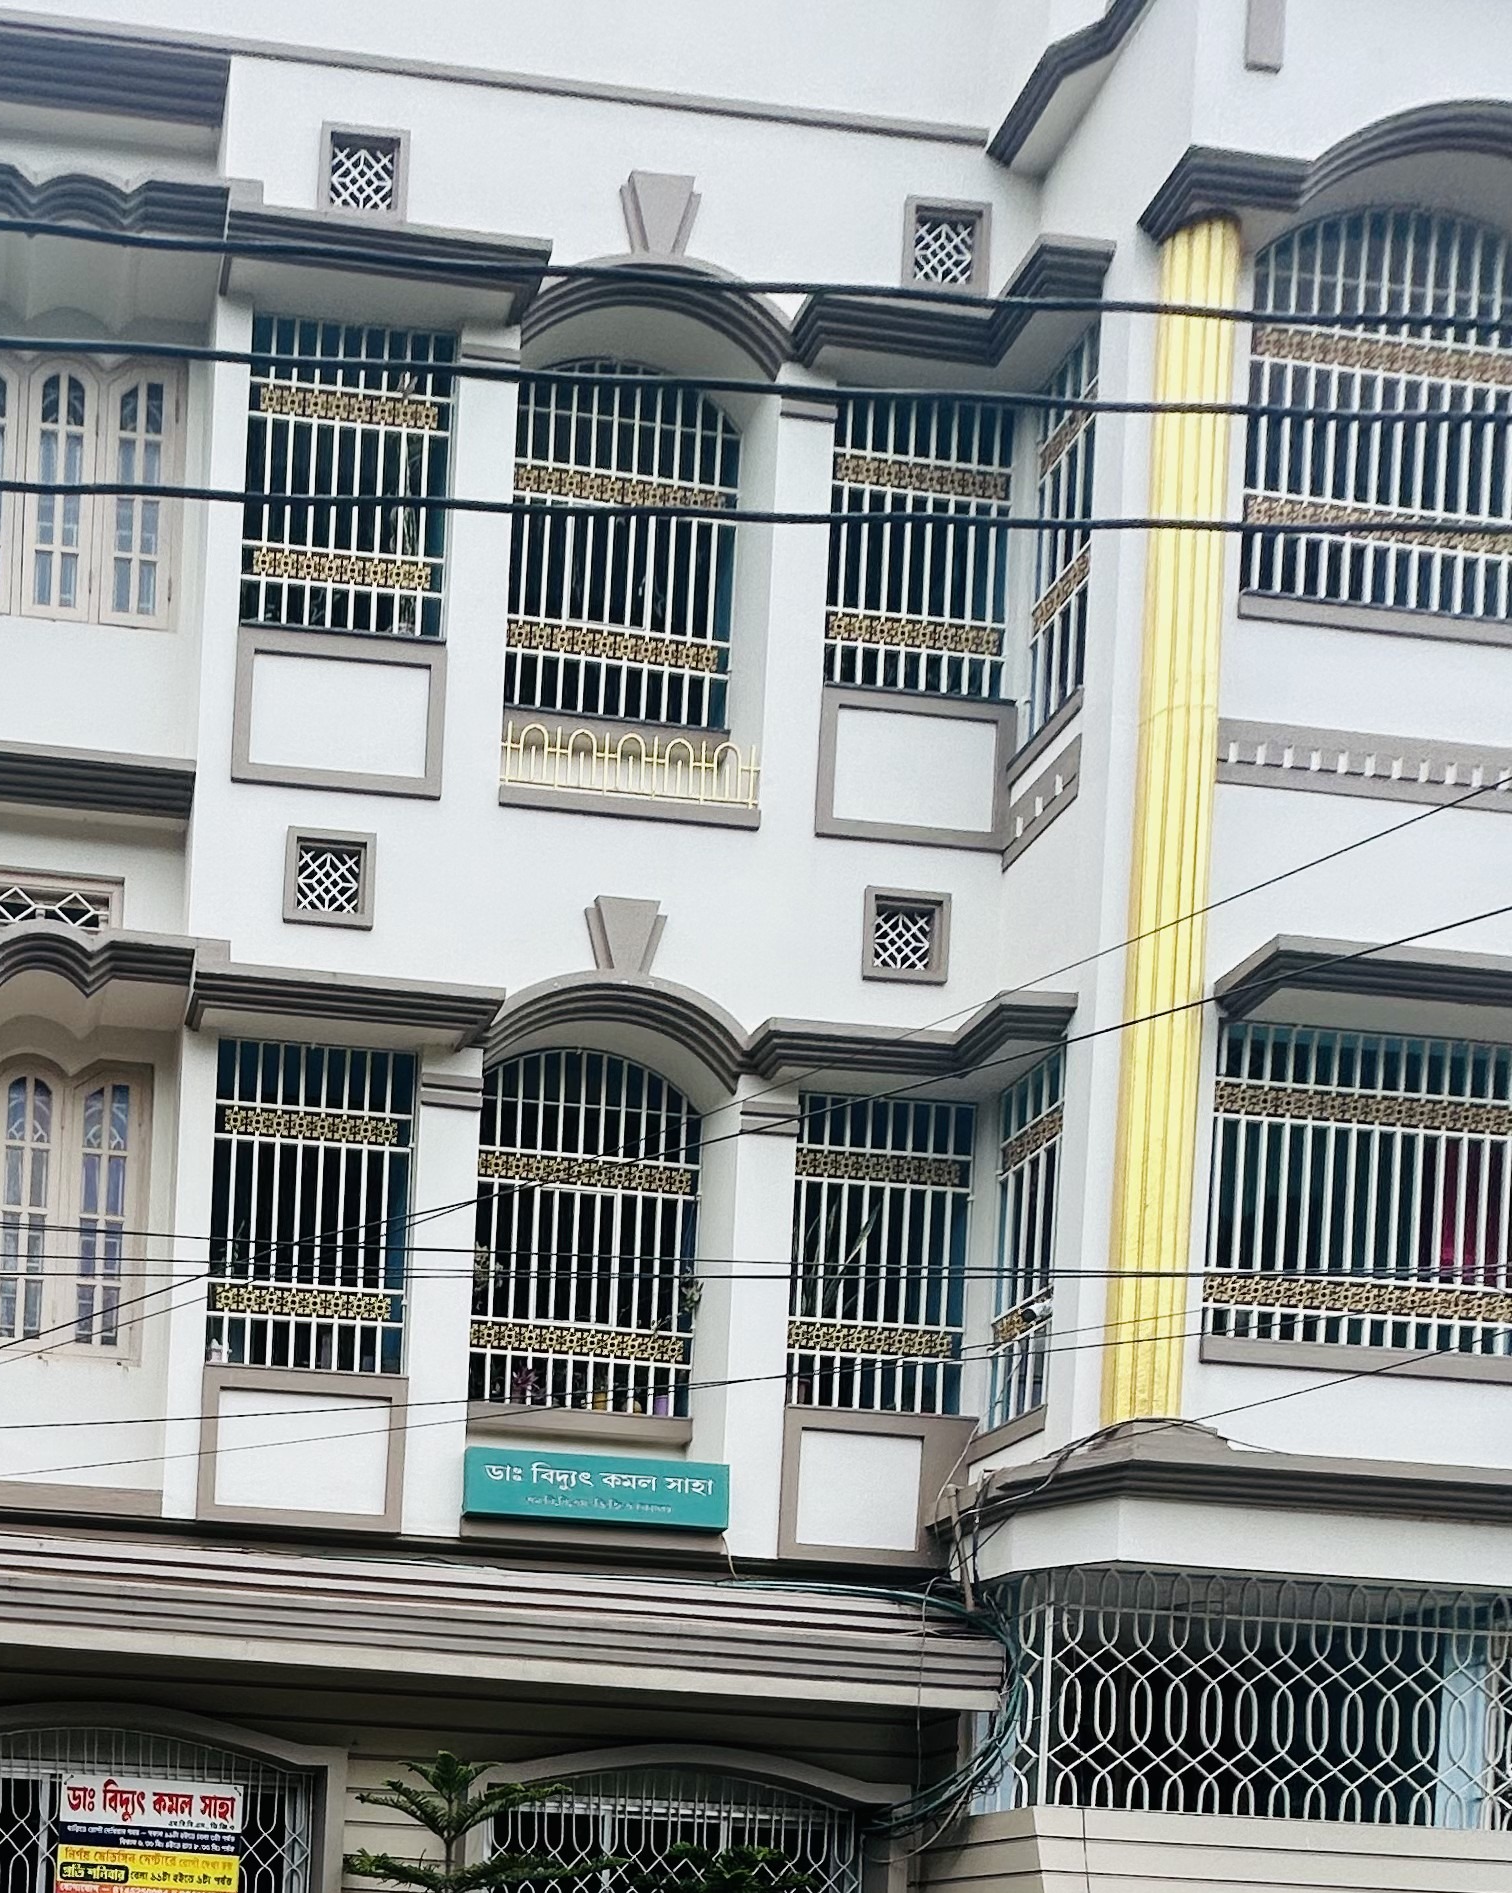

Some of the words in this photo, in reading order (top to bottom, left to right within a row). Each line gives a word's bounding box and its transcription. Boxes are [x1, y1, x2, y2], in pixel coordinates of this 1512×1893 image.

[484, 1464, 523, 1482] ডাঃ
[531, 1460, 593, 1491] বিদ্যুৎ
[599, 1472, 657, 1491] কমল
[665, 1476, 713, 1496] সাহা
[66, 1786, 95, 1811] ডাঃ
[101, 1778, 146, 1822] বিদ্যুৎ
[151, 1792, 193, 1817] কমল
[198, 1795, 235, 1823] সাহা
[86, 1864, 125, 1880] শনিবার
